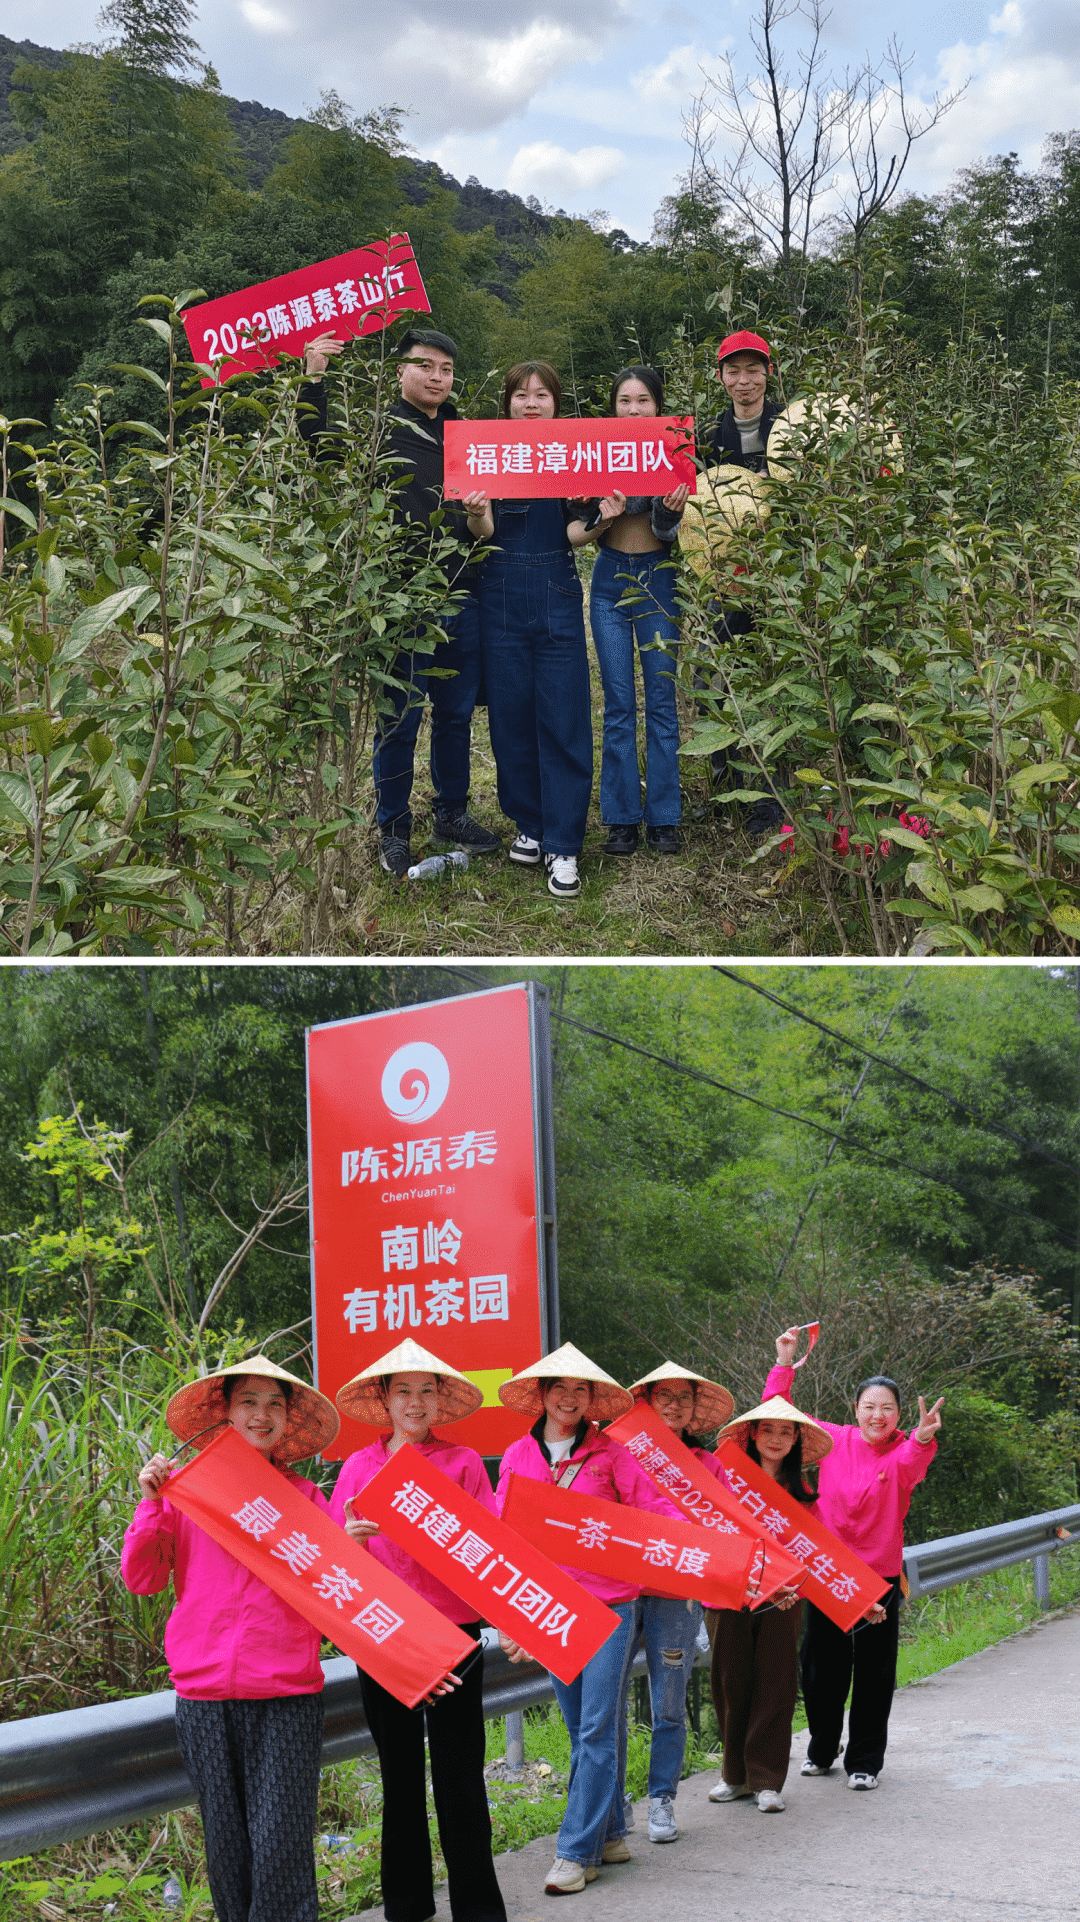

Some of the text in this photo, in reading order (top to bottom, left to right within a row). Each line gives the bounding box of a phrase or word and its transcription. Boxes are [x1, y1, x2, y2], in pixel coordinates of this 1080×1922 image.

[203, 264, 406, 361] 2023陈源泰茶山行
[465, 440, 674, 476] 福建漳州团队
[341, 1130, 498, 1187] 陈源泰
[381, 1184, 456, 1203] ChenYuanTai
[381, 1218, 463, 1273] 南岭
[342, 1274, 509, 1334] 有机茶园
[231, 1496, 405, 1644] 最美茶园
[390, 1480, 578, 1647] 福建厦门团队
[545, 1517, 711, 1578] 一茶一态度
